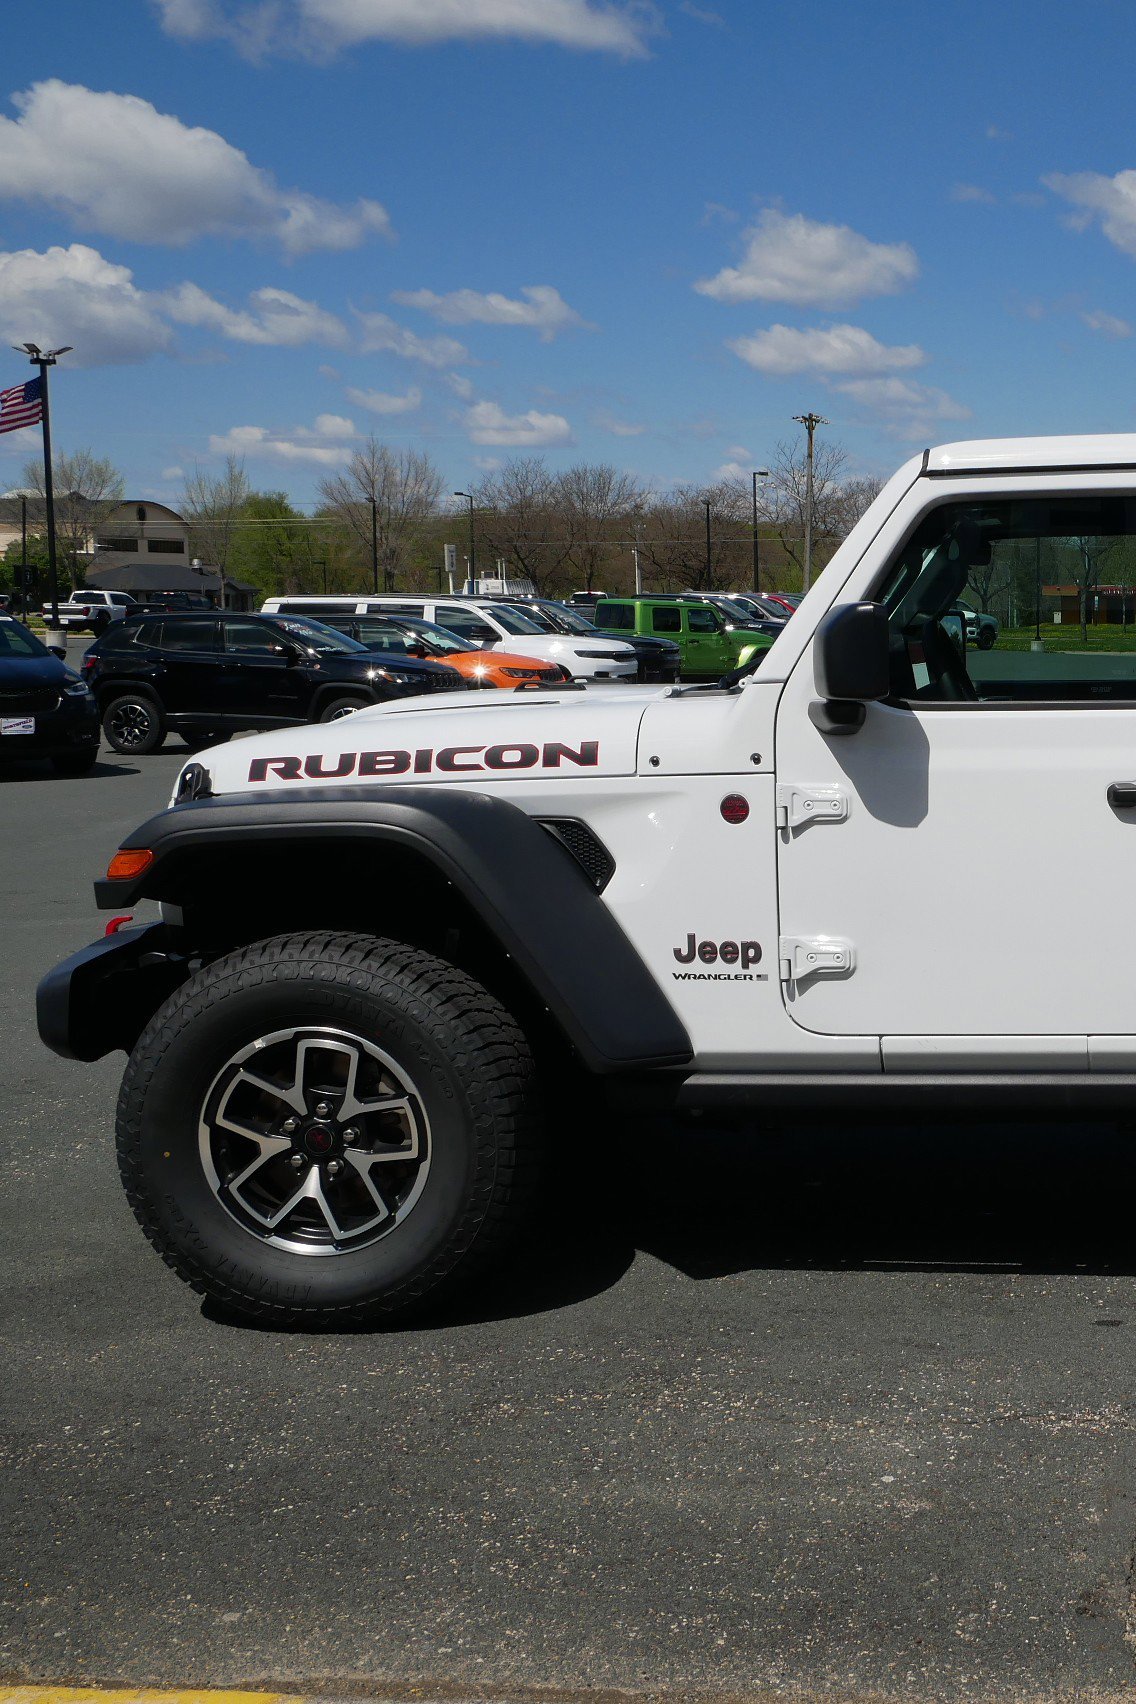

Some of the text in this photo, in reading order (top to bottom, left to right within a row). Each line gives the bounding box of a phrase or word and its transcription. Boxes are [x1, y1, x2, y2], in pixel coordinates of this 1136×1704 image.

[248, 741, 600, 782] RUBICON
[673, 933, 762, 970] Jeep
[672, 973, 754, 981] WRANGLER
